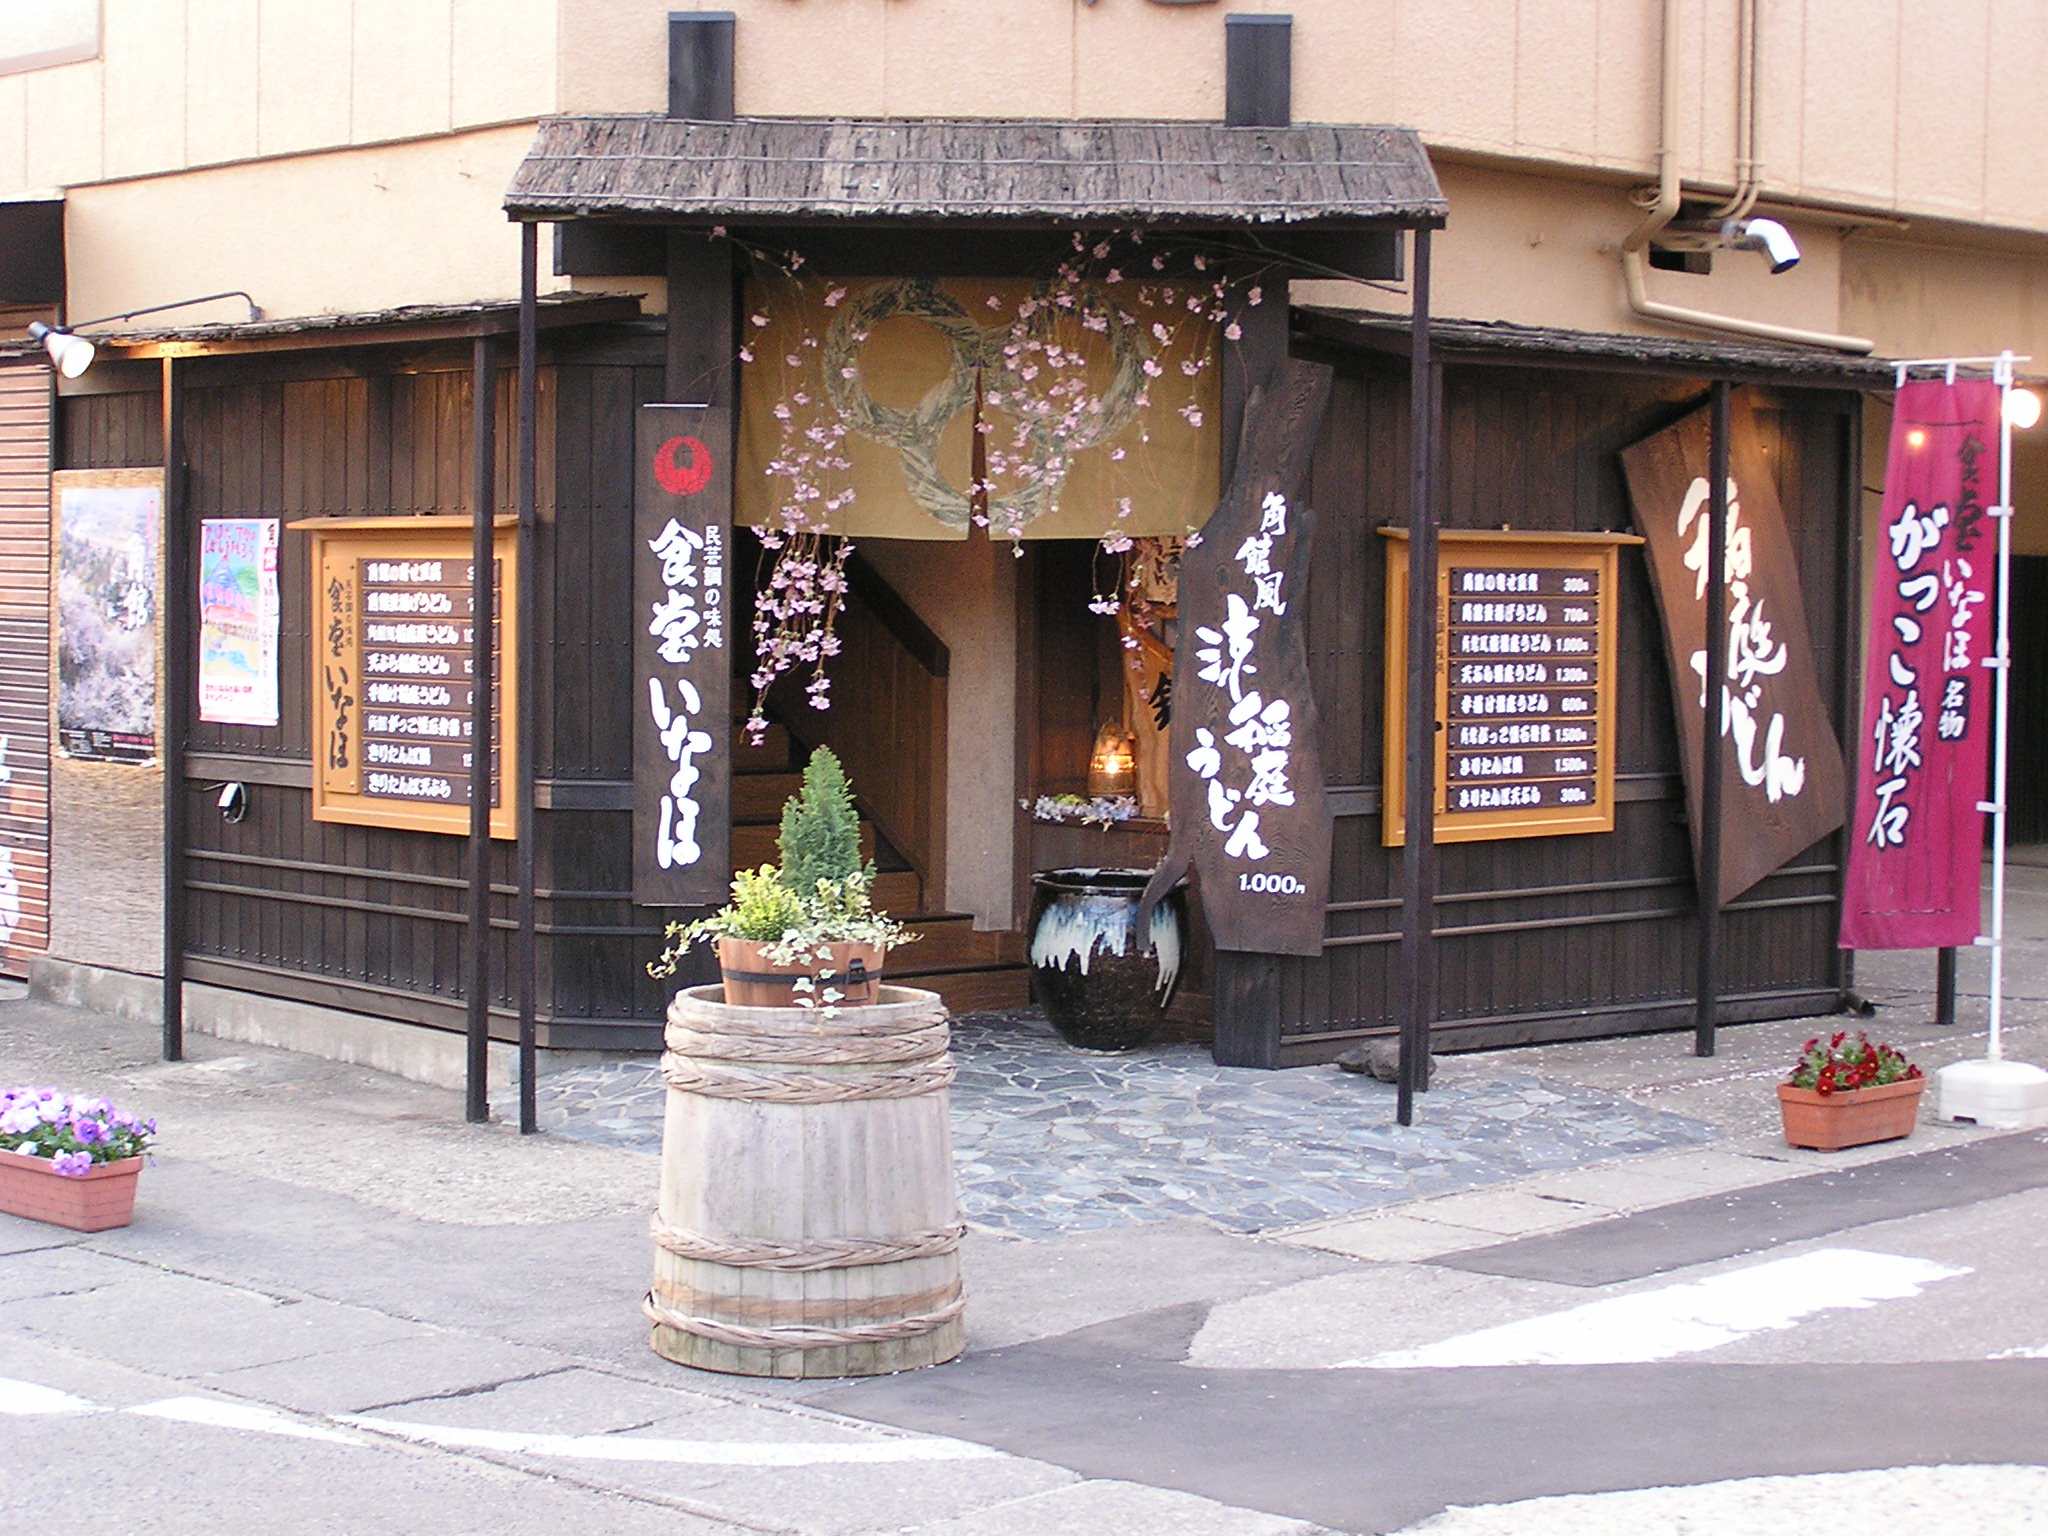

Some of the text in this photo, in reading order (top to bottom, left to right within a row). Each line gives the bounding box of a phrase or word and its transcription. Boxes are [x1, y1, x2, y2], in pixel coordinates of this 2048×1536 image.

[702, 525, 723, 650] 民芸調の味処
[1235, 490, 1288, 616] 角館風
[1937, 679, 1968, 741] 名物
